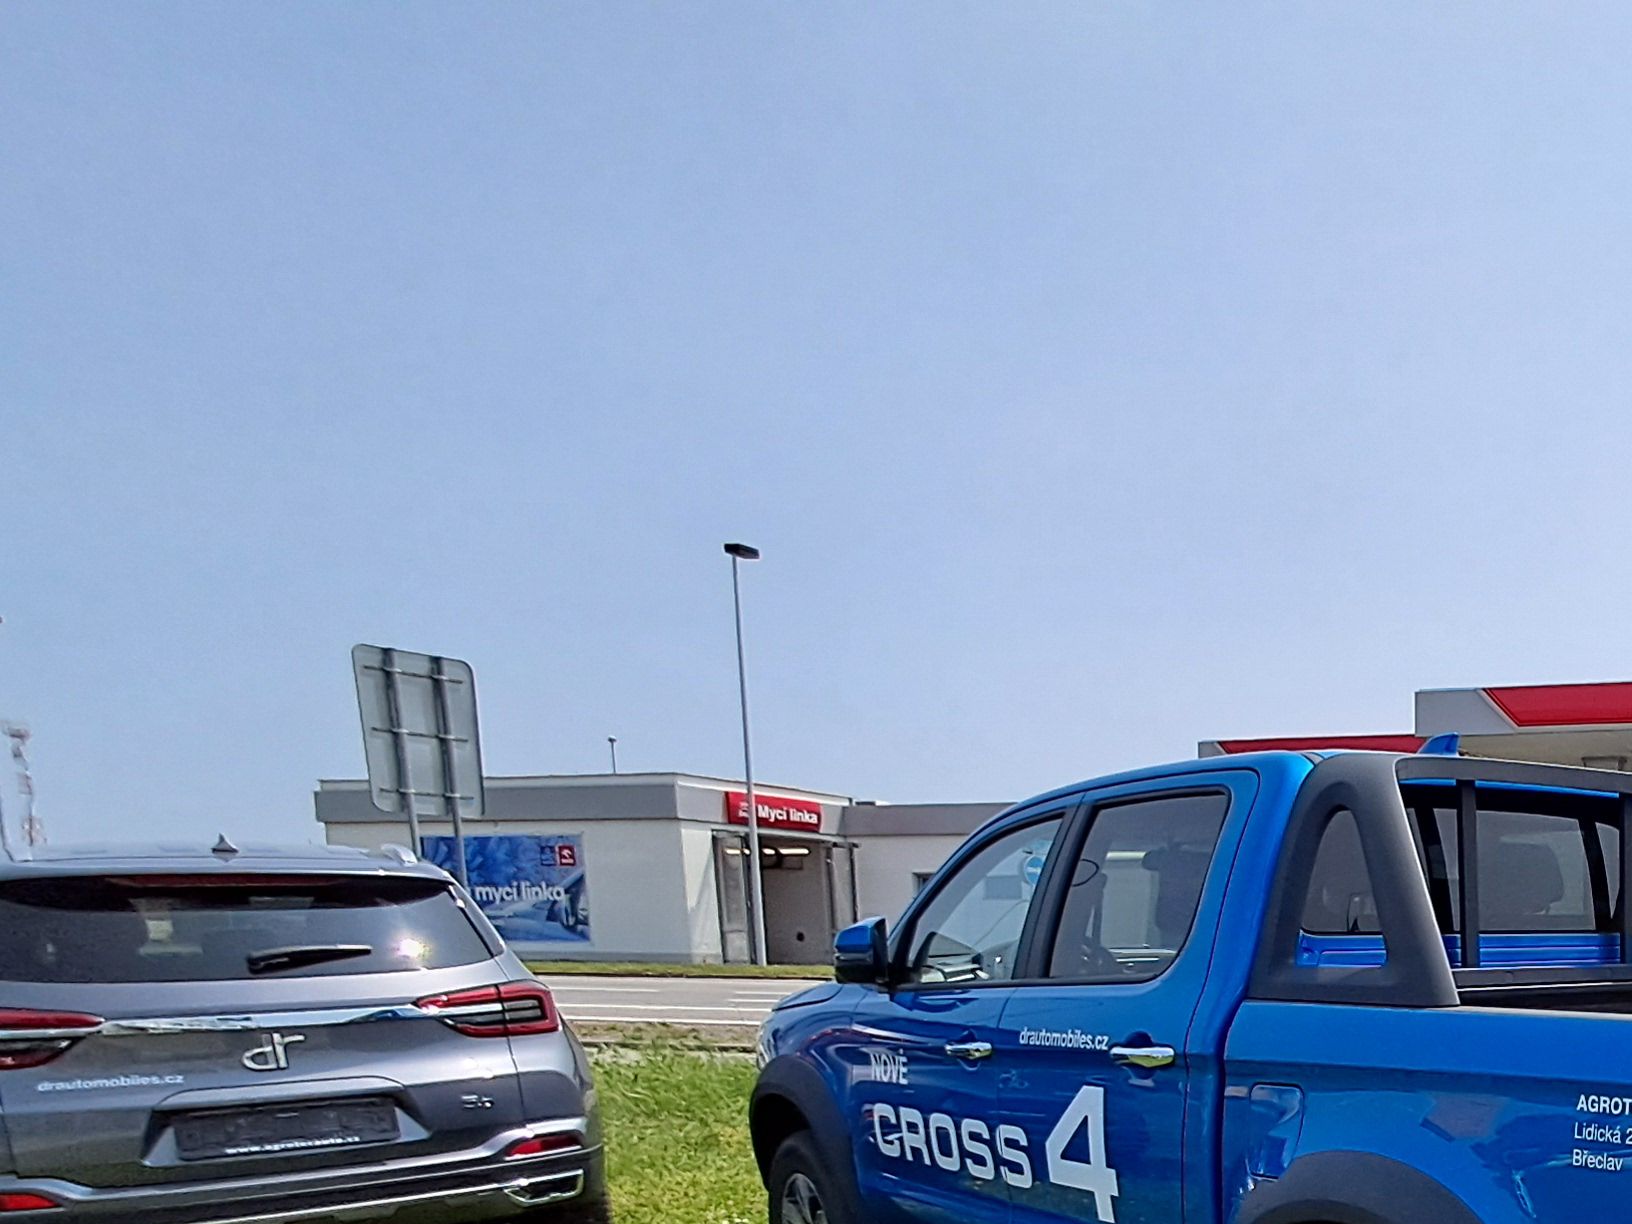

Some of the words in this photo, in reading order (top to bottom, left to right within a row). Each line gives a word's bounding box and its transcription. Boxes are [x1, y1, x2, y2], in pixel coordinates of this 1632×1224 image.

[789, 808, 818, 824] linka
[521, 882, 565, 901] linka
[1019, 1027, 1109, 1050] drautomobiles.cz
[869, 1048, 909, 1085] NOVÉ
[37, 1073, 185, 1092] drautomobiles.cz
[1574, 1122, 1622, 1144] Lidická
[872, 1102, 1033, 1189] CROSS
[1045, 1085, 1119, 1223] 4
[1572, 1148, 1623, 1171] Břeclav
